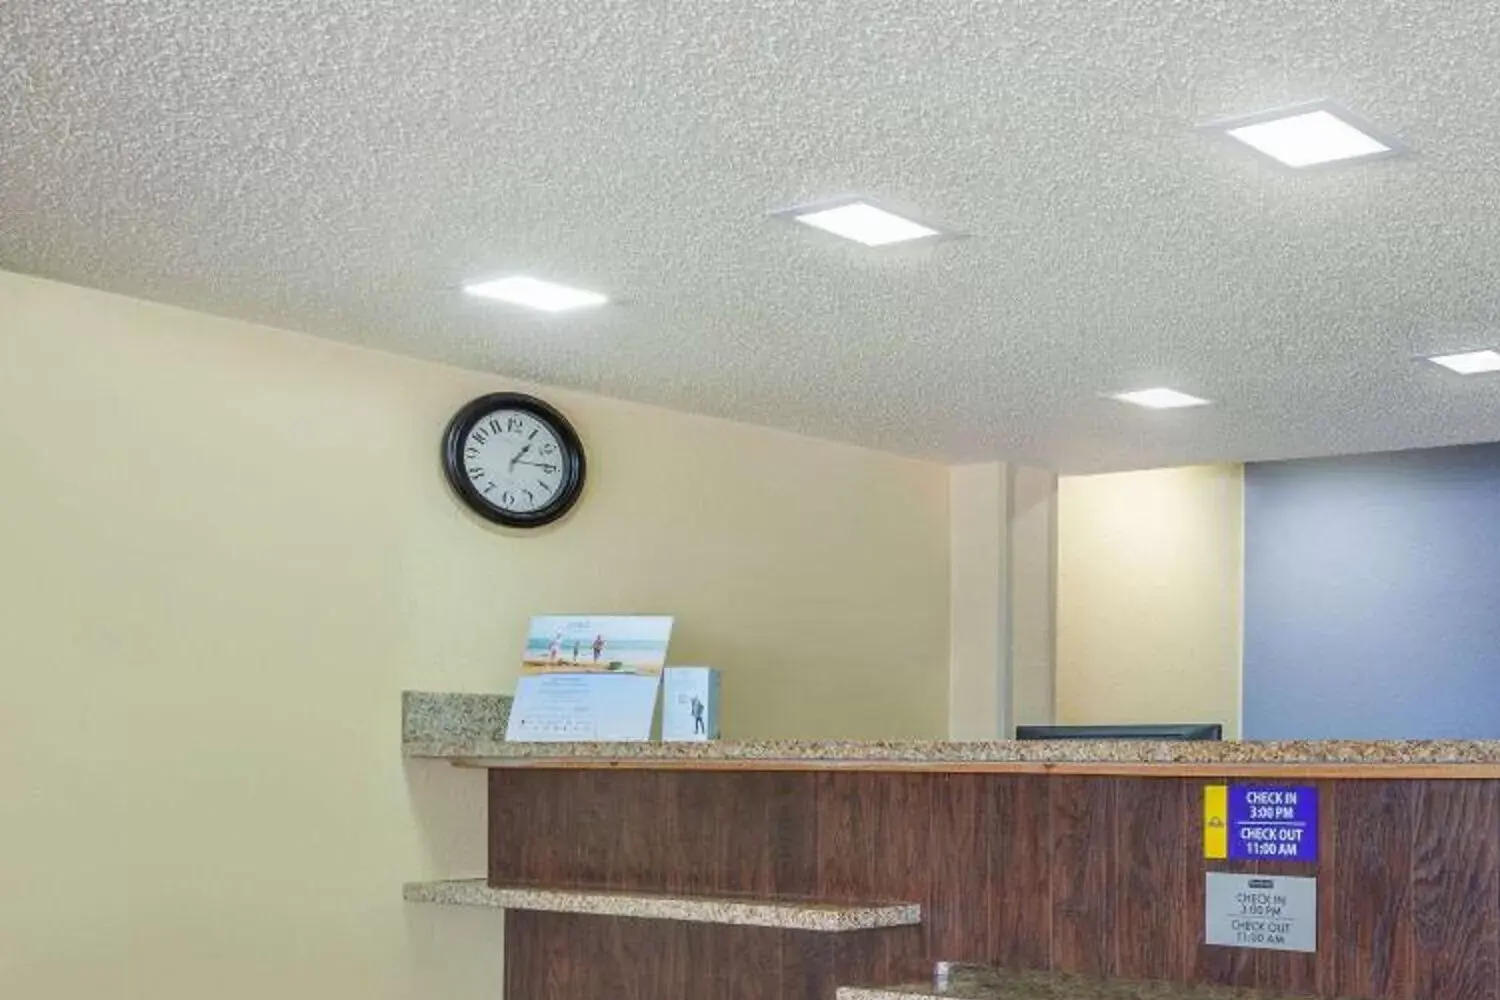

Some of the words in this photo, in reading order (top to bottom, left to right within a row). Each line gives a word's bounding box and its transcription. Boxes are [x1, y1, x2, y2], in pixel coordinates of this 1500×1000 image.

[1246, 791, 1283, 805] CHECK
[1285, 792, 1297, 805] IN
[1249, 806, 1274, 819] 3:00
[1275, 807, 1294, 819] PM
[1240, 827, 1277, 841] CHECK
[1279, 829, 1304, 841] OUT
[1247, 842, 1277, 855] 11:00
[1278, 844, 1297, 856] AM
[1267, 921, 1290, 933] OUT
